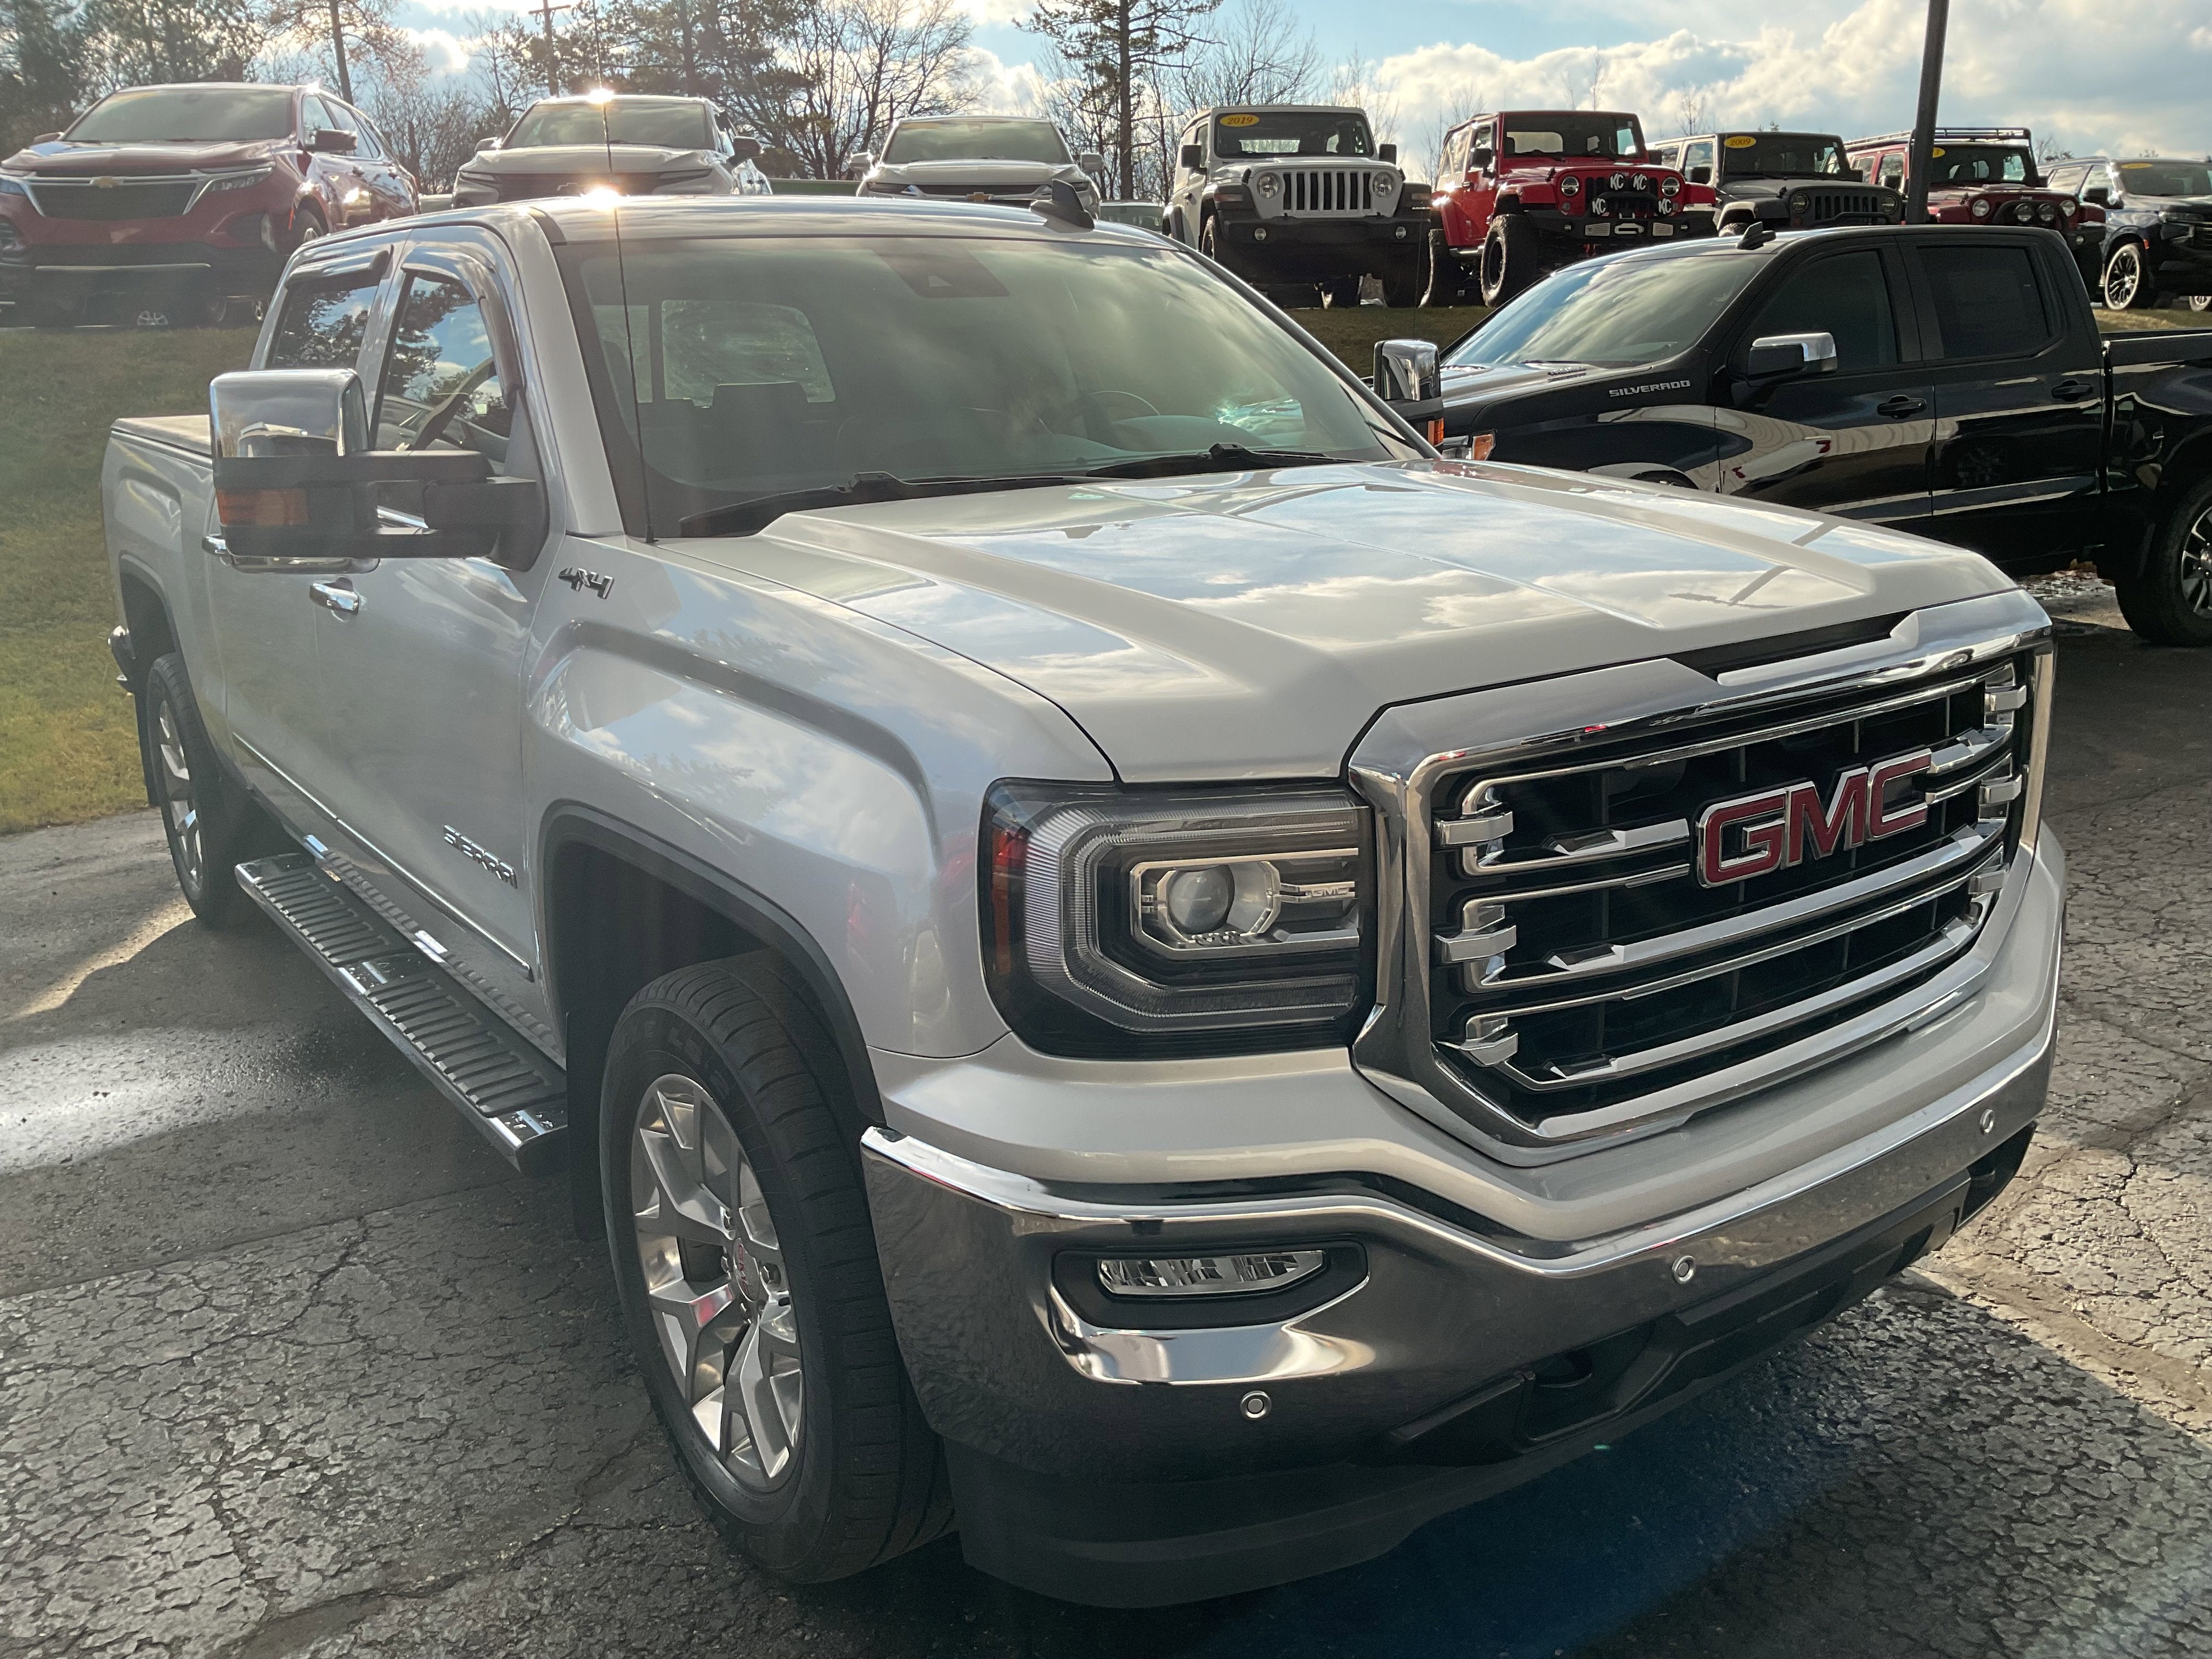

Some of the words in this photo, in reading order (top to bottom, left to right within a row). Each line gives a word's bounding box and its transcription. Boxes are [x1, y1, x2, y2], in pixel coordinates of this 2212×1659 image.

[1227, 116, 1252, 125] 2019
[1730, 138, 1751, 146] 2009
[1610, 173, 1624, 190] KC
[1633, 173, 1647, 190] KC
[1592, 198, 1606, 215] KC
[1658, 198, 1672, 215] KC
[1609, 380, 1691, 397] SILVERADO
[1697, 748, 1933, 889] GMC
[443, 825, 518, 889] SIERRA
[1311, 885, 1350, 898] GMC
[738, 1244, 751, 1296] GMC
